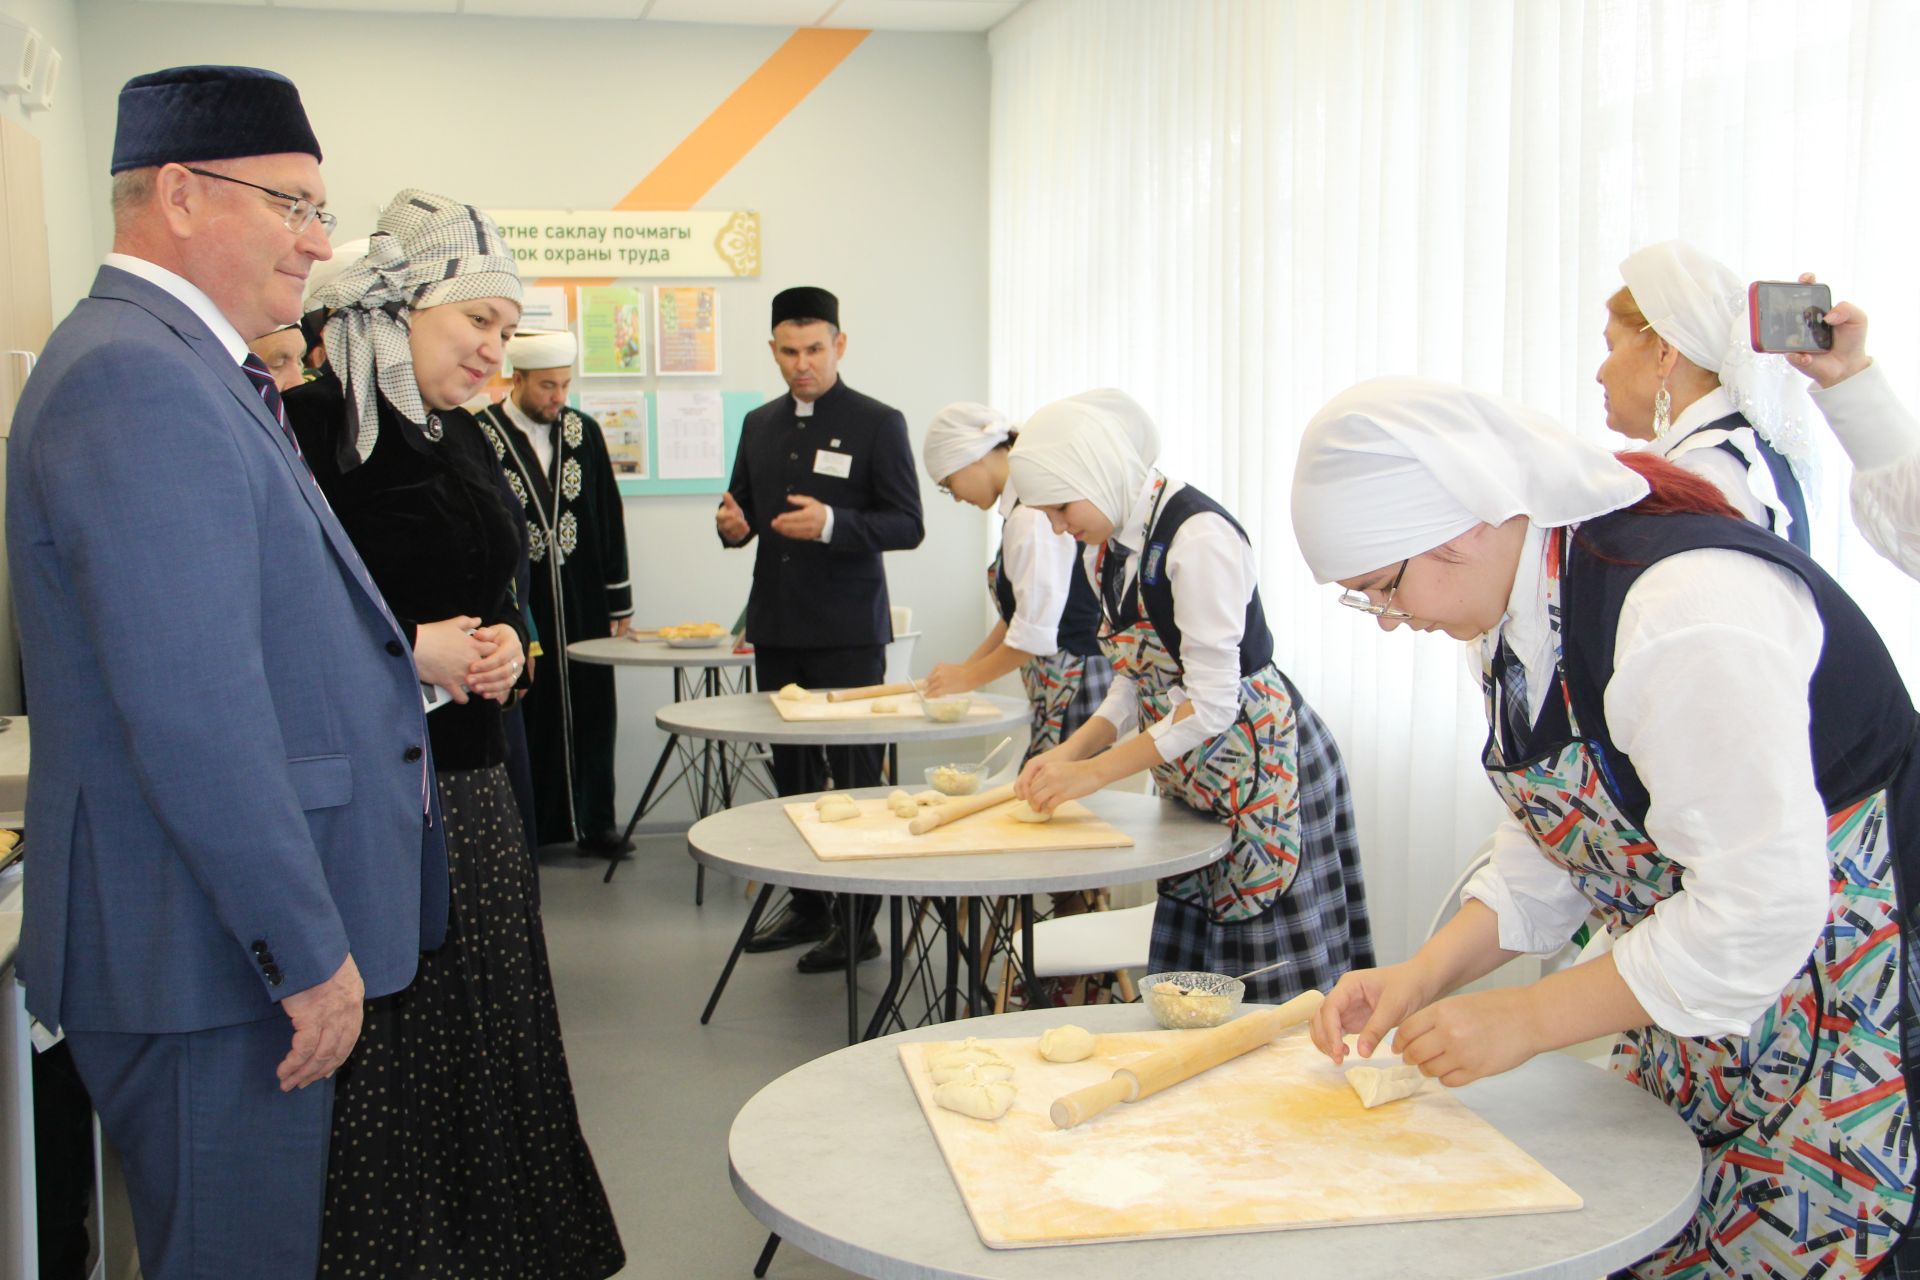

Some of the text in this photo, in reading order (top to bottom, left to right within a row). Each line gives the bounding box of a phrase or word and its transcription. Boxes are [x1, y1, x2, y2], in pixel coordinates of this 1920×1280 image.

[545, 225, 607, 243] саклау
[613, 225, 691, 239] почмагы
[544, 247, 612, 265] охраны
[618, 247, 671, 265] труда
